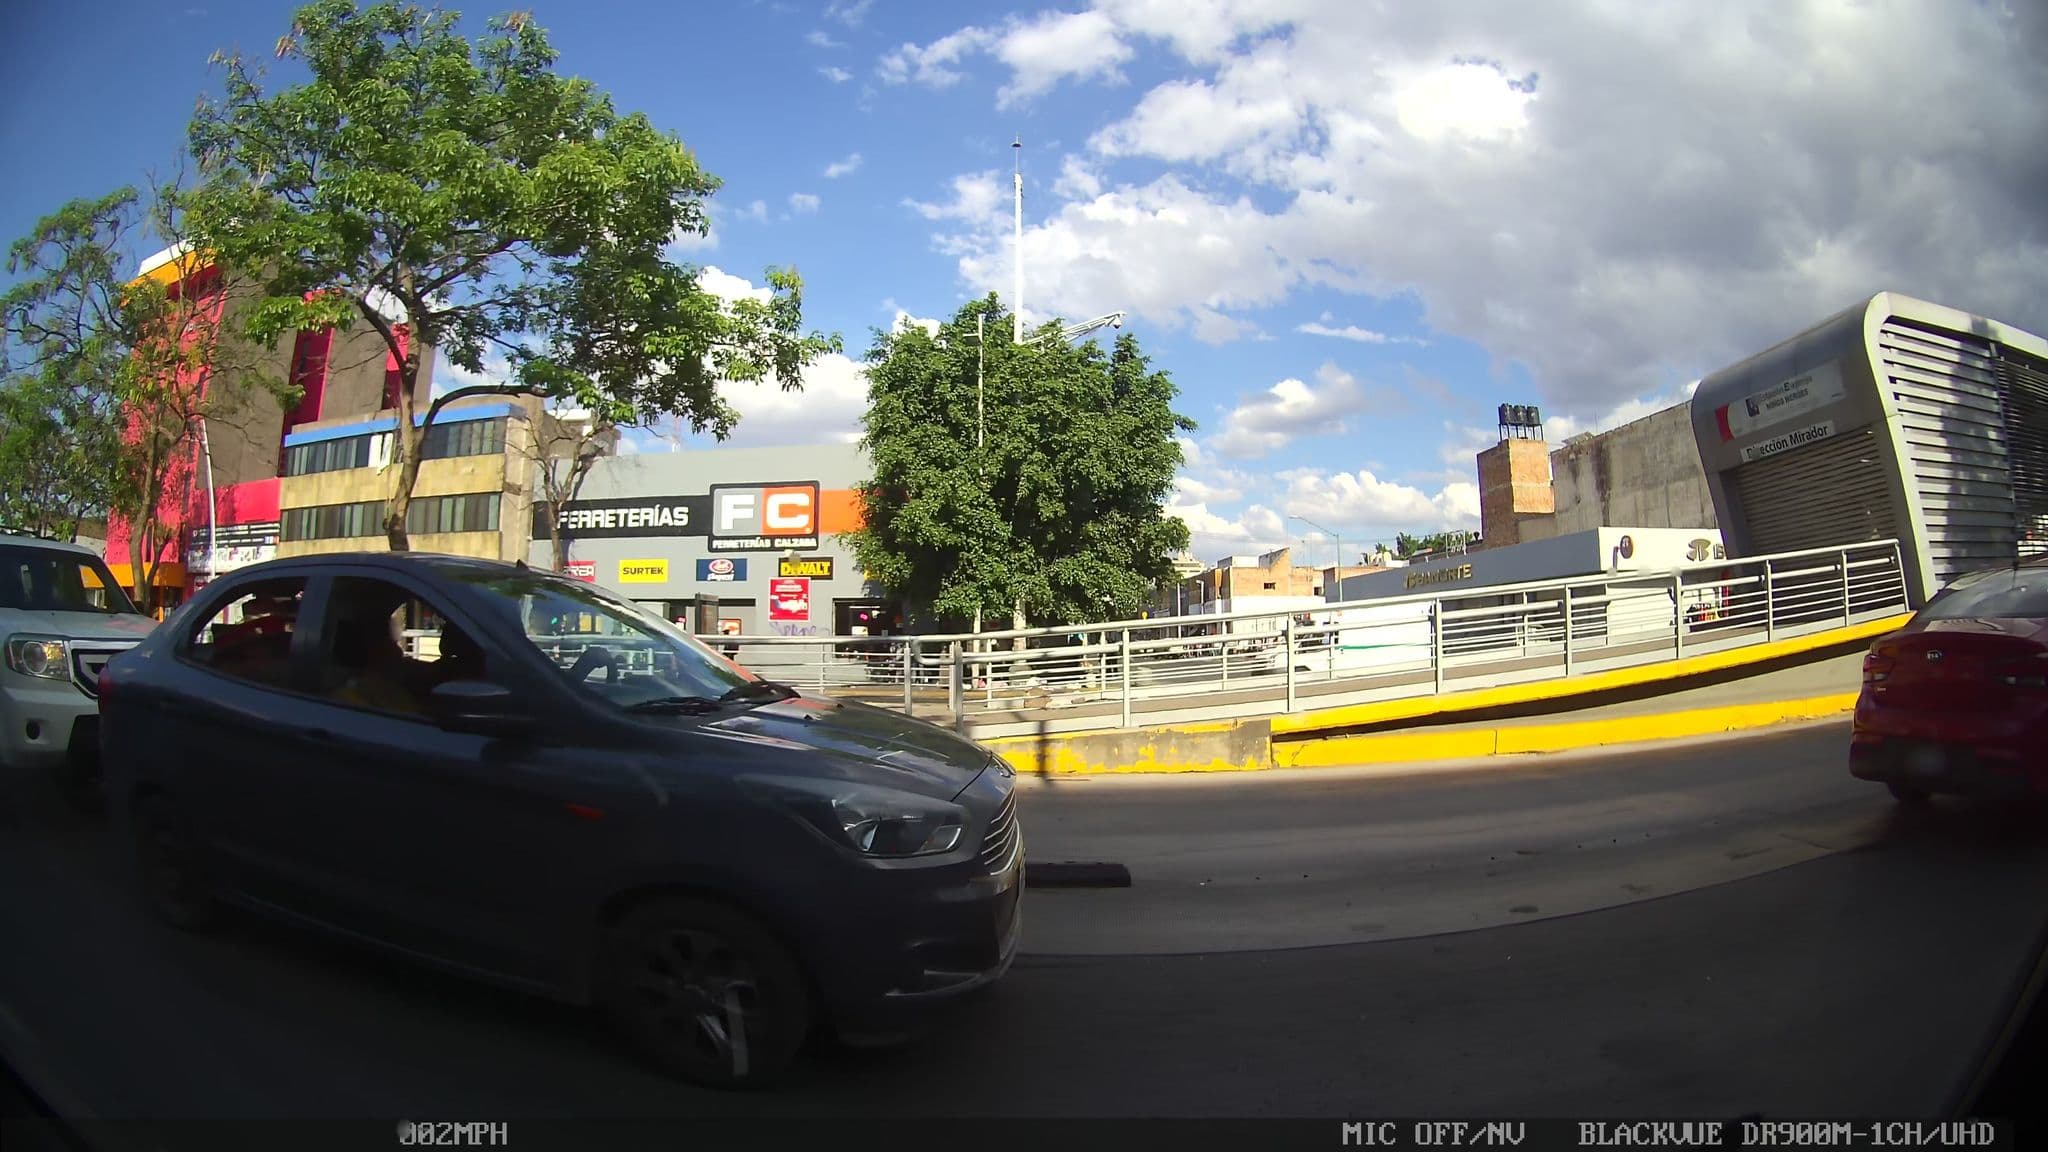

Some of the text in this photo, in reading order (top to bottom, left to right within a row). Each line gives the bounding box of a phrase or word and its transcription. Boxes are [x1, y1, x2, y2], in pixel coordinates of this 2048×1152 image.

[1789, 425, 1828, 446] Mirador
[557, 504, 689, 529] FERRETERÍAS
[622, 566, 664, 575] SURTEK
[781, 561, 831, 576] DWALT
